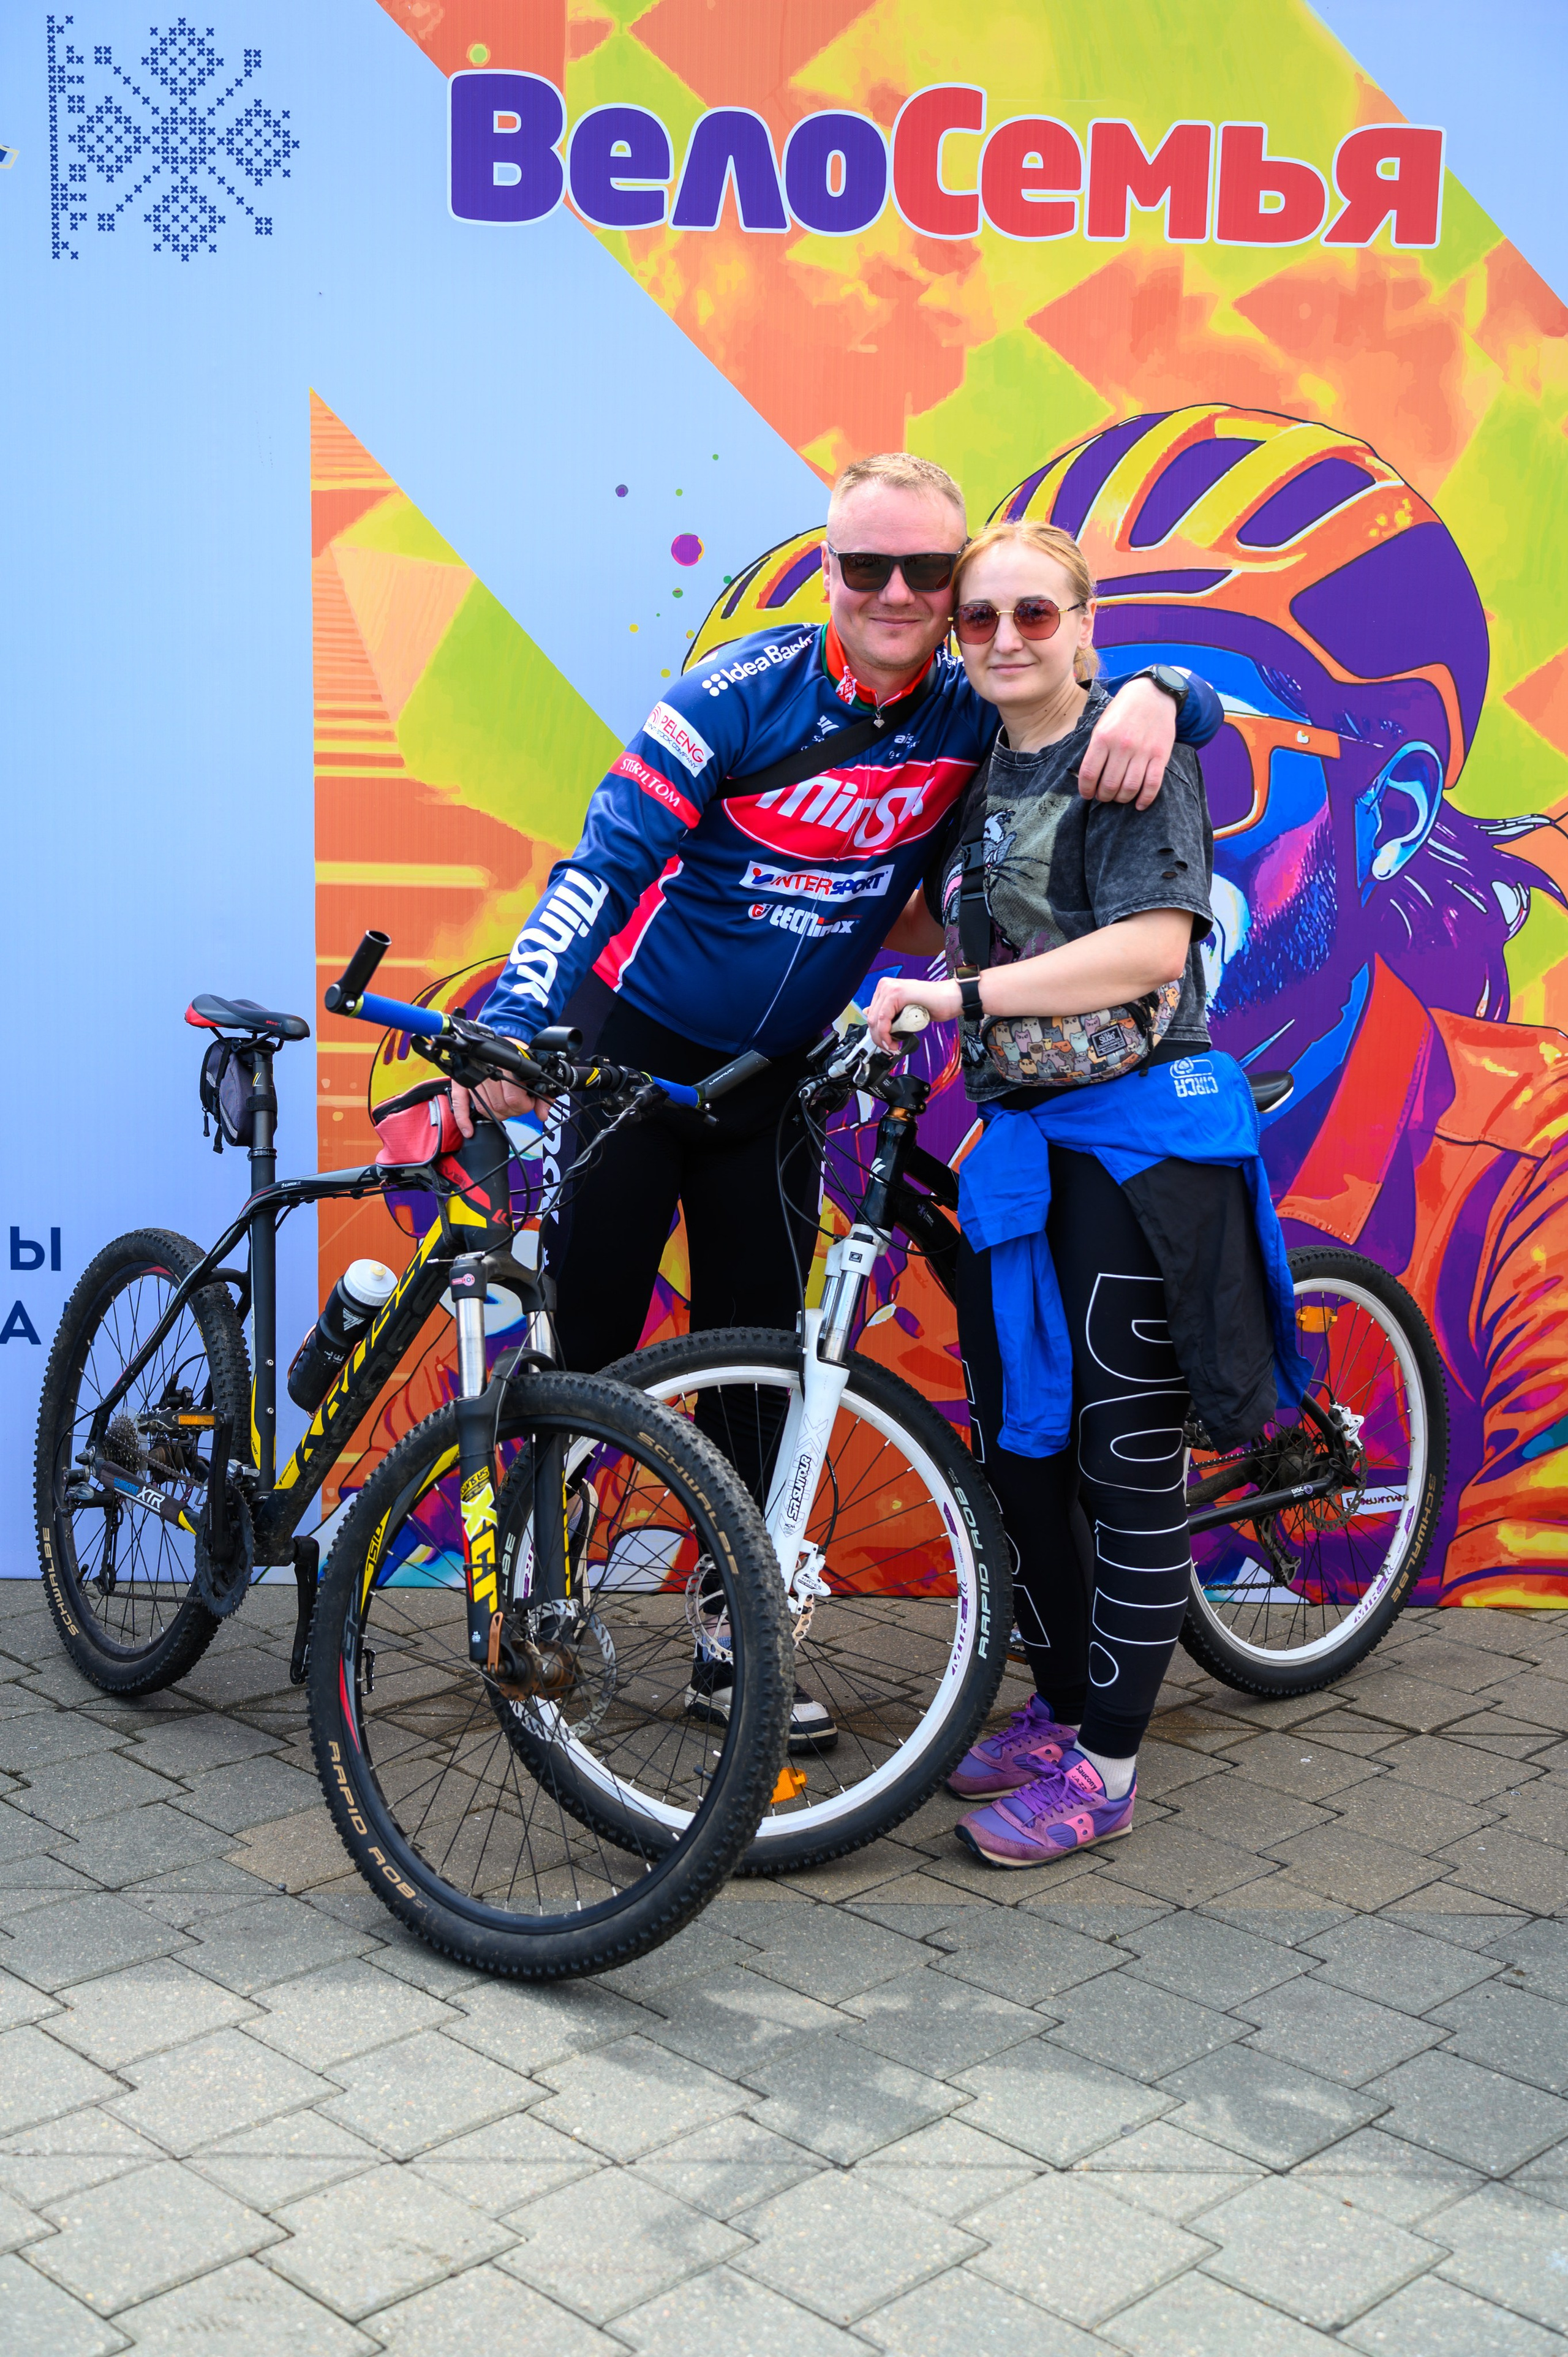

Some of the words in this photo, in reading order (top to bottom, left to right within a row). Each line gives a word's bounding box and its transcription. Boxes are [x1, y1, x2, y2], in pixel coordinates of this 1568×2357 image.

[720, 656, 771, 684] Idea
[661, 715, 704, 763] PELENG
[671, 742, 698, 769] COMPANY
[620, 758, 680, 807] STERILTOM
[770, 871, 886, 896] INTERSPORT
[1172, 1076, 1219, 1099] CIRCA
[113, 1477, 140, 1496] SHIMANO
[137, 1486, 165, 1508] XTR
[638, 1431, 739, 1575] SCHWALBE
[954, 1485, 984, 1550] ROB
[1390, 1473, 1437, 1603] SCHWALBE
[42, 1527, 80, 1637] SCHWALBE
[978, 1563, 991, 1659] RAPID
[1071, 1774, 1088, 1791] JAZZ
[1076, 1765, 1098, 1790] Saucony
[328, 1740, 368, 1835] RAPID
[368, 1846, 417, 1899] ROB
